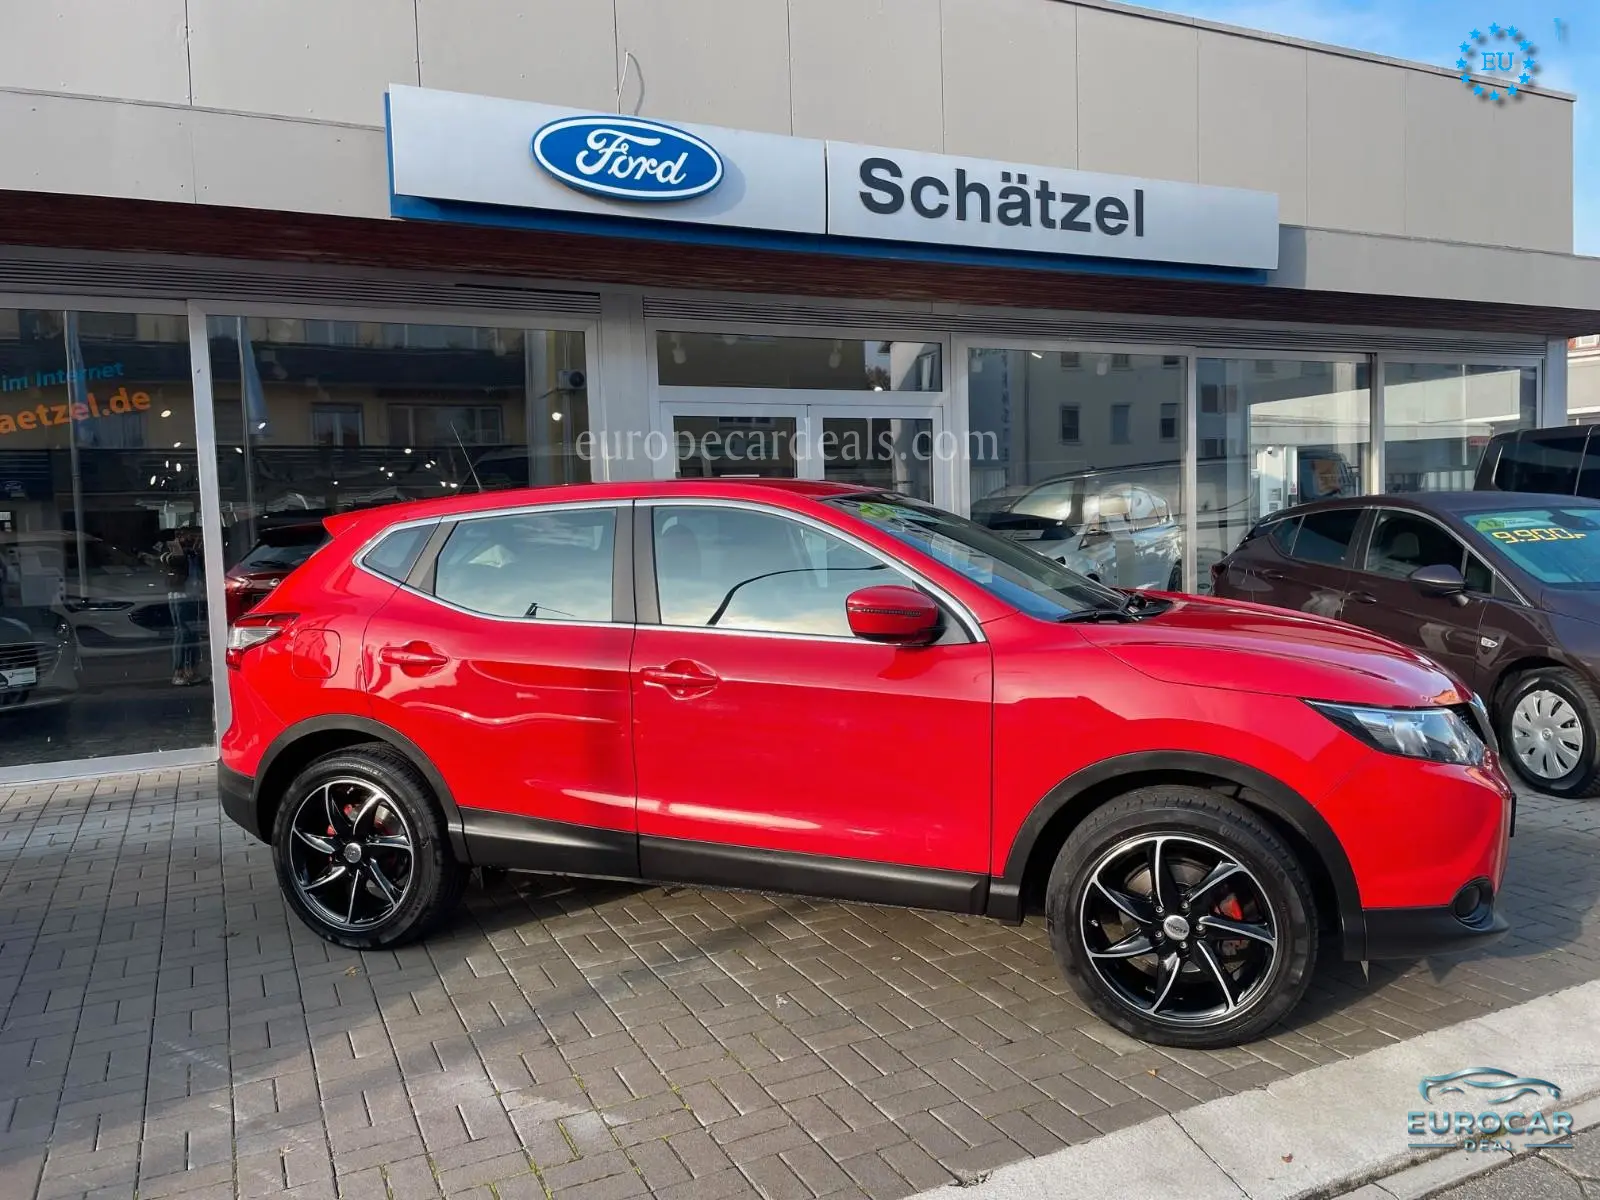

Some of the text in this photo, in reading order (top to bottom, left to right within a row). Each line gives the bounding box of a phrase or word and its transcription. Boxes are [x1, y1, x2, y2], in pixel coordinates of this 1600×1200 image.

[575, 128, 689, 185] Ford
[859, 157, 1145, 237] Schätzel
[2, 362, 125, 392] im Internet
